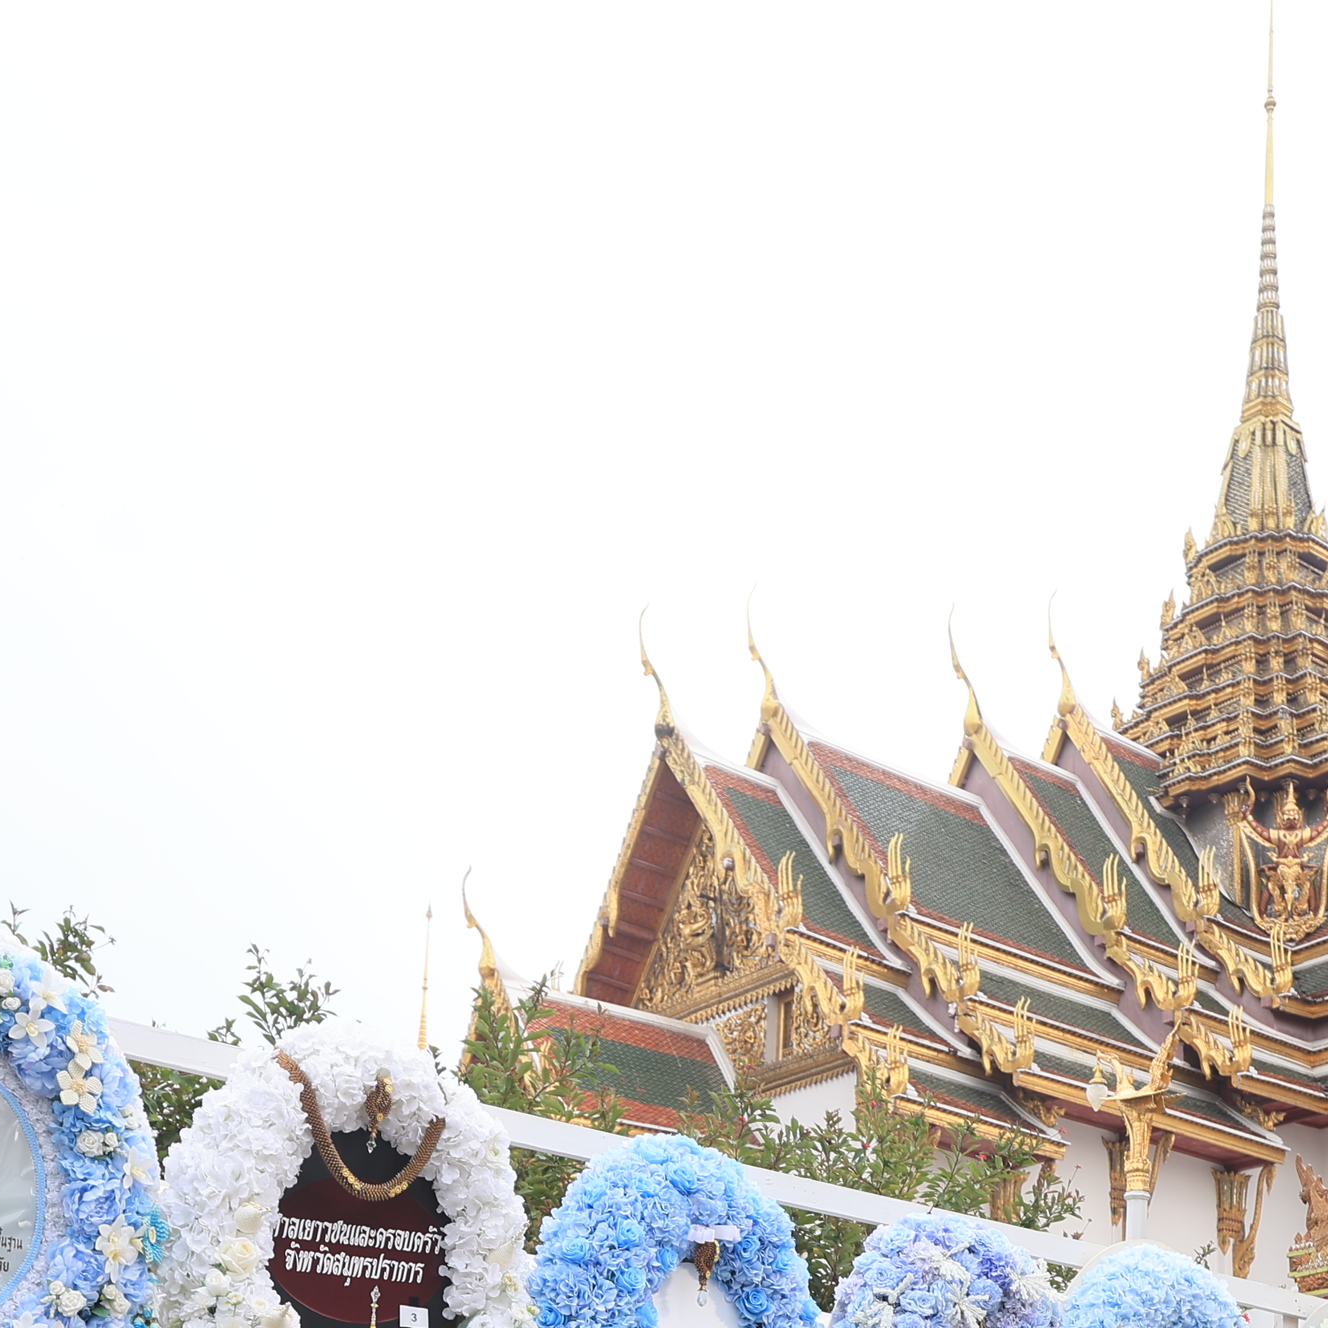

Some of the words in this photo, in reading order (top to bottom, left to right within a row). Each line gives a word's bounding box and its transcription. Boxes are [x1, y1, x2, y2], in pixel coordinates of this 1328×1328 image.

[285, 1241, 425, 1287] จังหวัดสมุทรปราการ
[410, 1312, 418, 1323] 3
